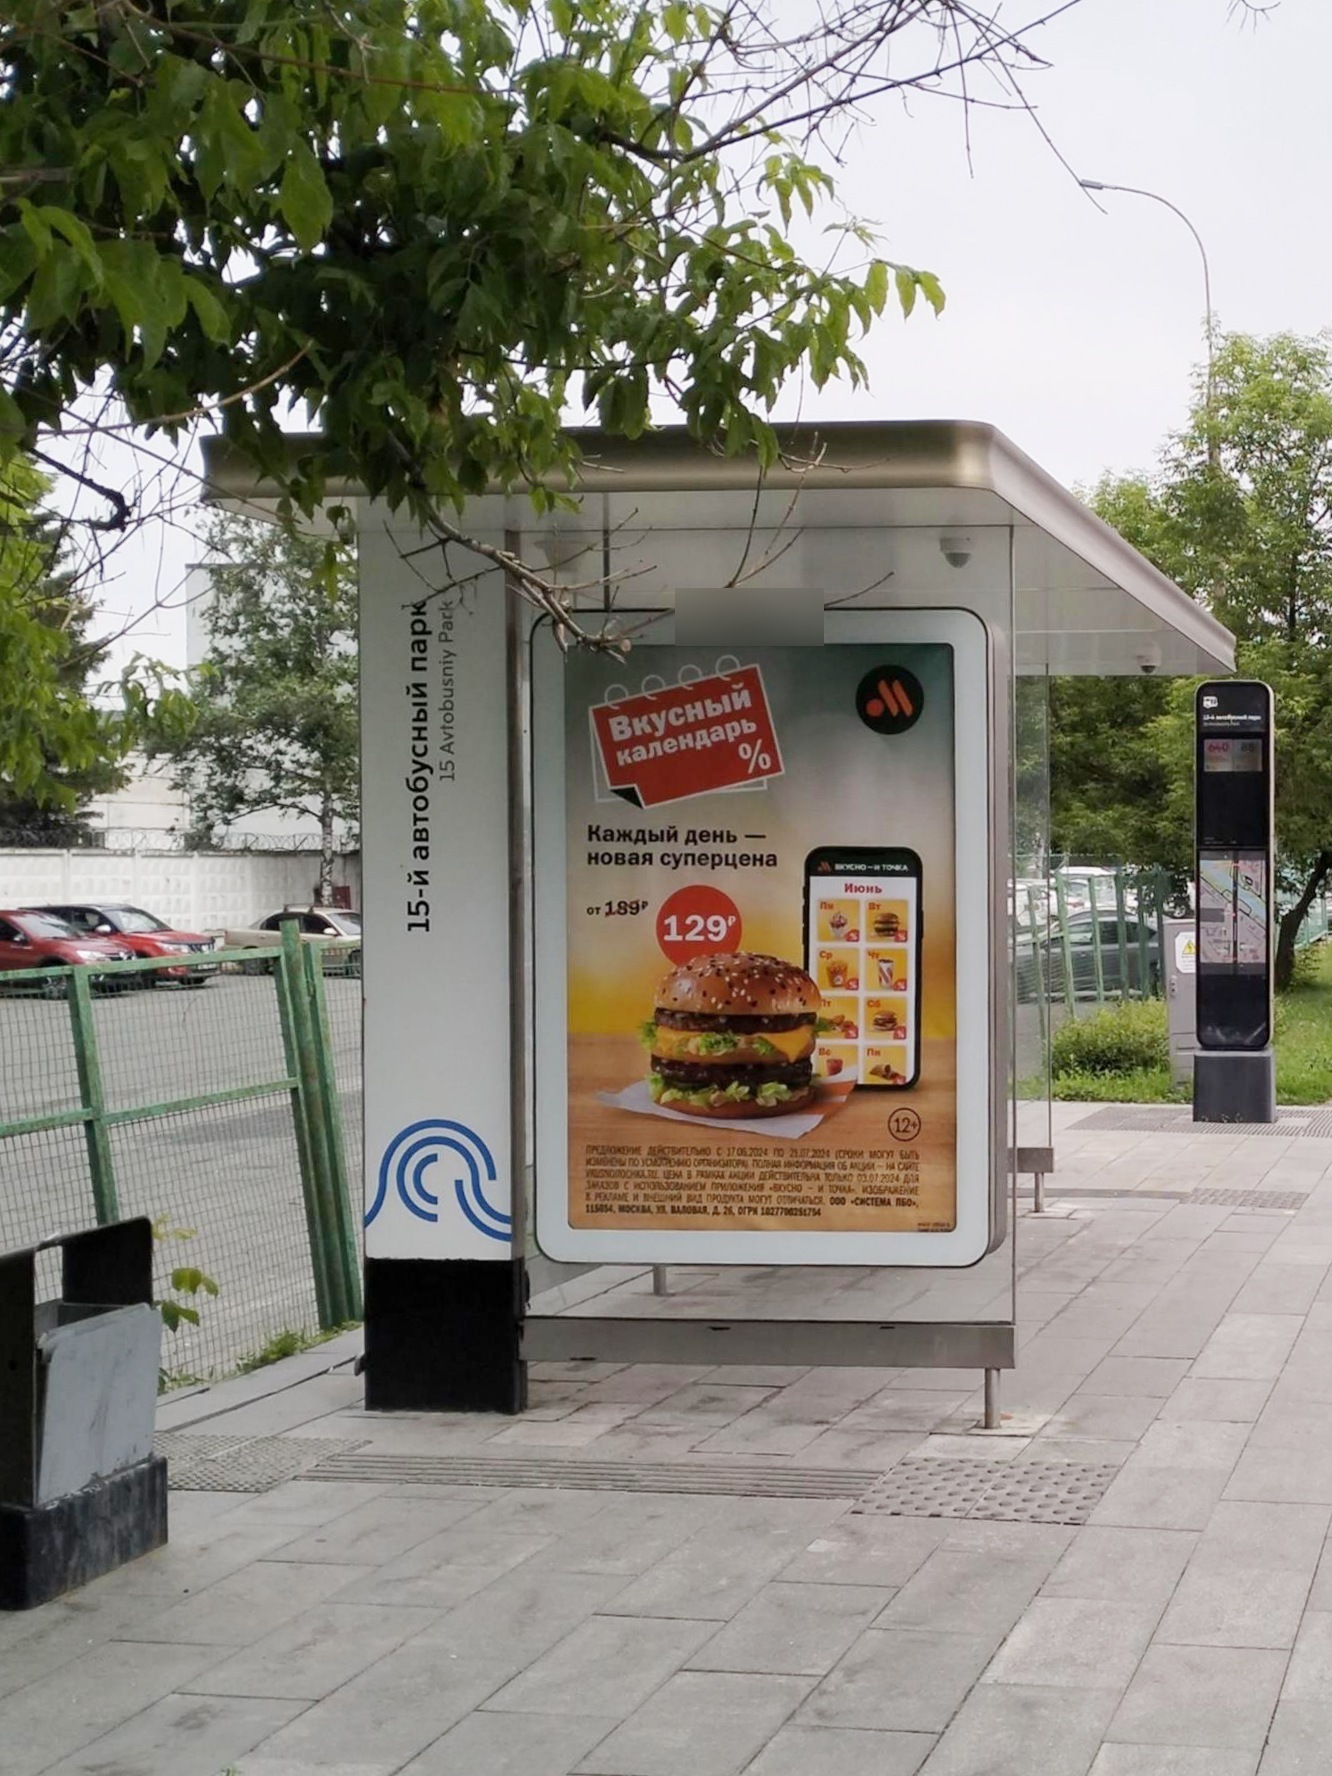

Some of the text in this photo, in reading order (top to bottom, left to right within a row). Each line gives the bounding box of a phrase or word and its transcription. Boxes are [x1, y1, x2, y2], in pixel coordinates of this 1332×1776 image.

[437, 600, 457, 781] 15 Avtobusniy Park
[608, 682, 752, 742] Вкусный
[616, 718, 758, 767] календарь
[738, 739, 772, 774] %
[404, 600, 434, 932] 15-й автобусный парк
[587, 824, 679, 846] Каждый
[684, 829, 738, 846] день
[587, 851, 778, 870] новая суперцена
[844, 883, 883, 894] Июнь
[586, 906, 601, 916] от
[894, 1116, 919, 1133] 12+
